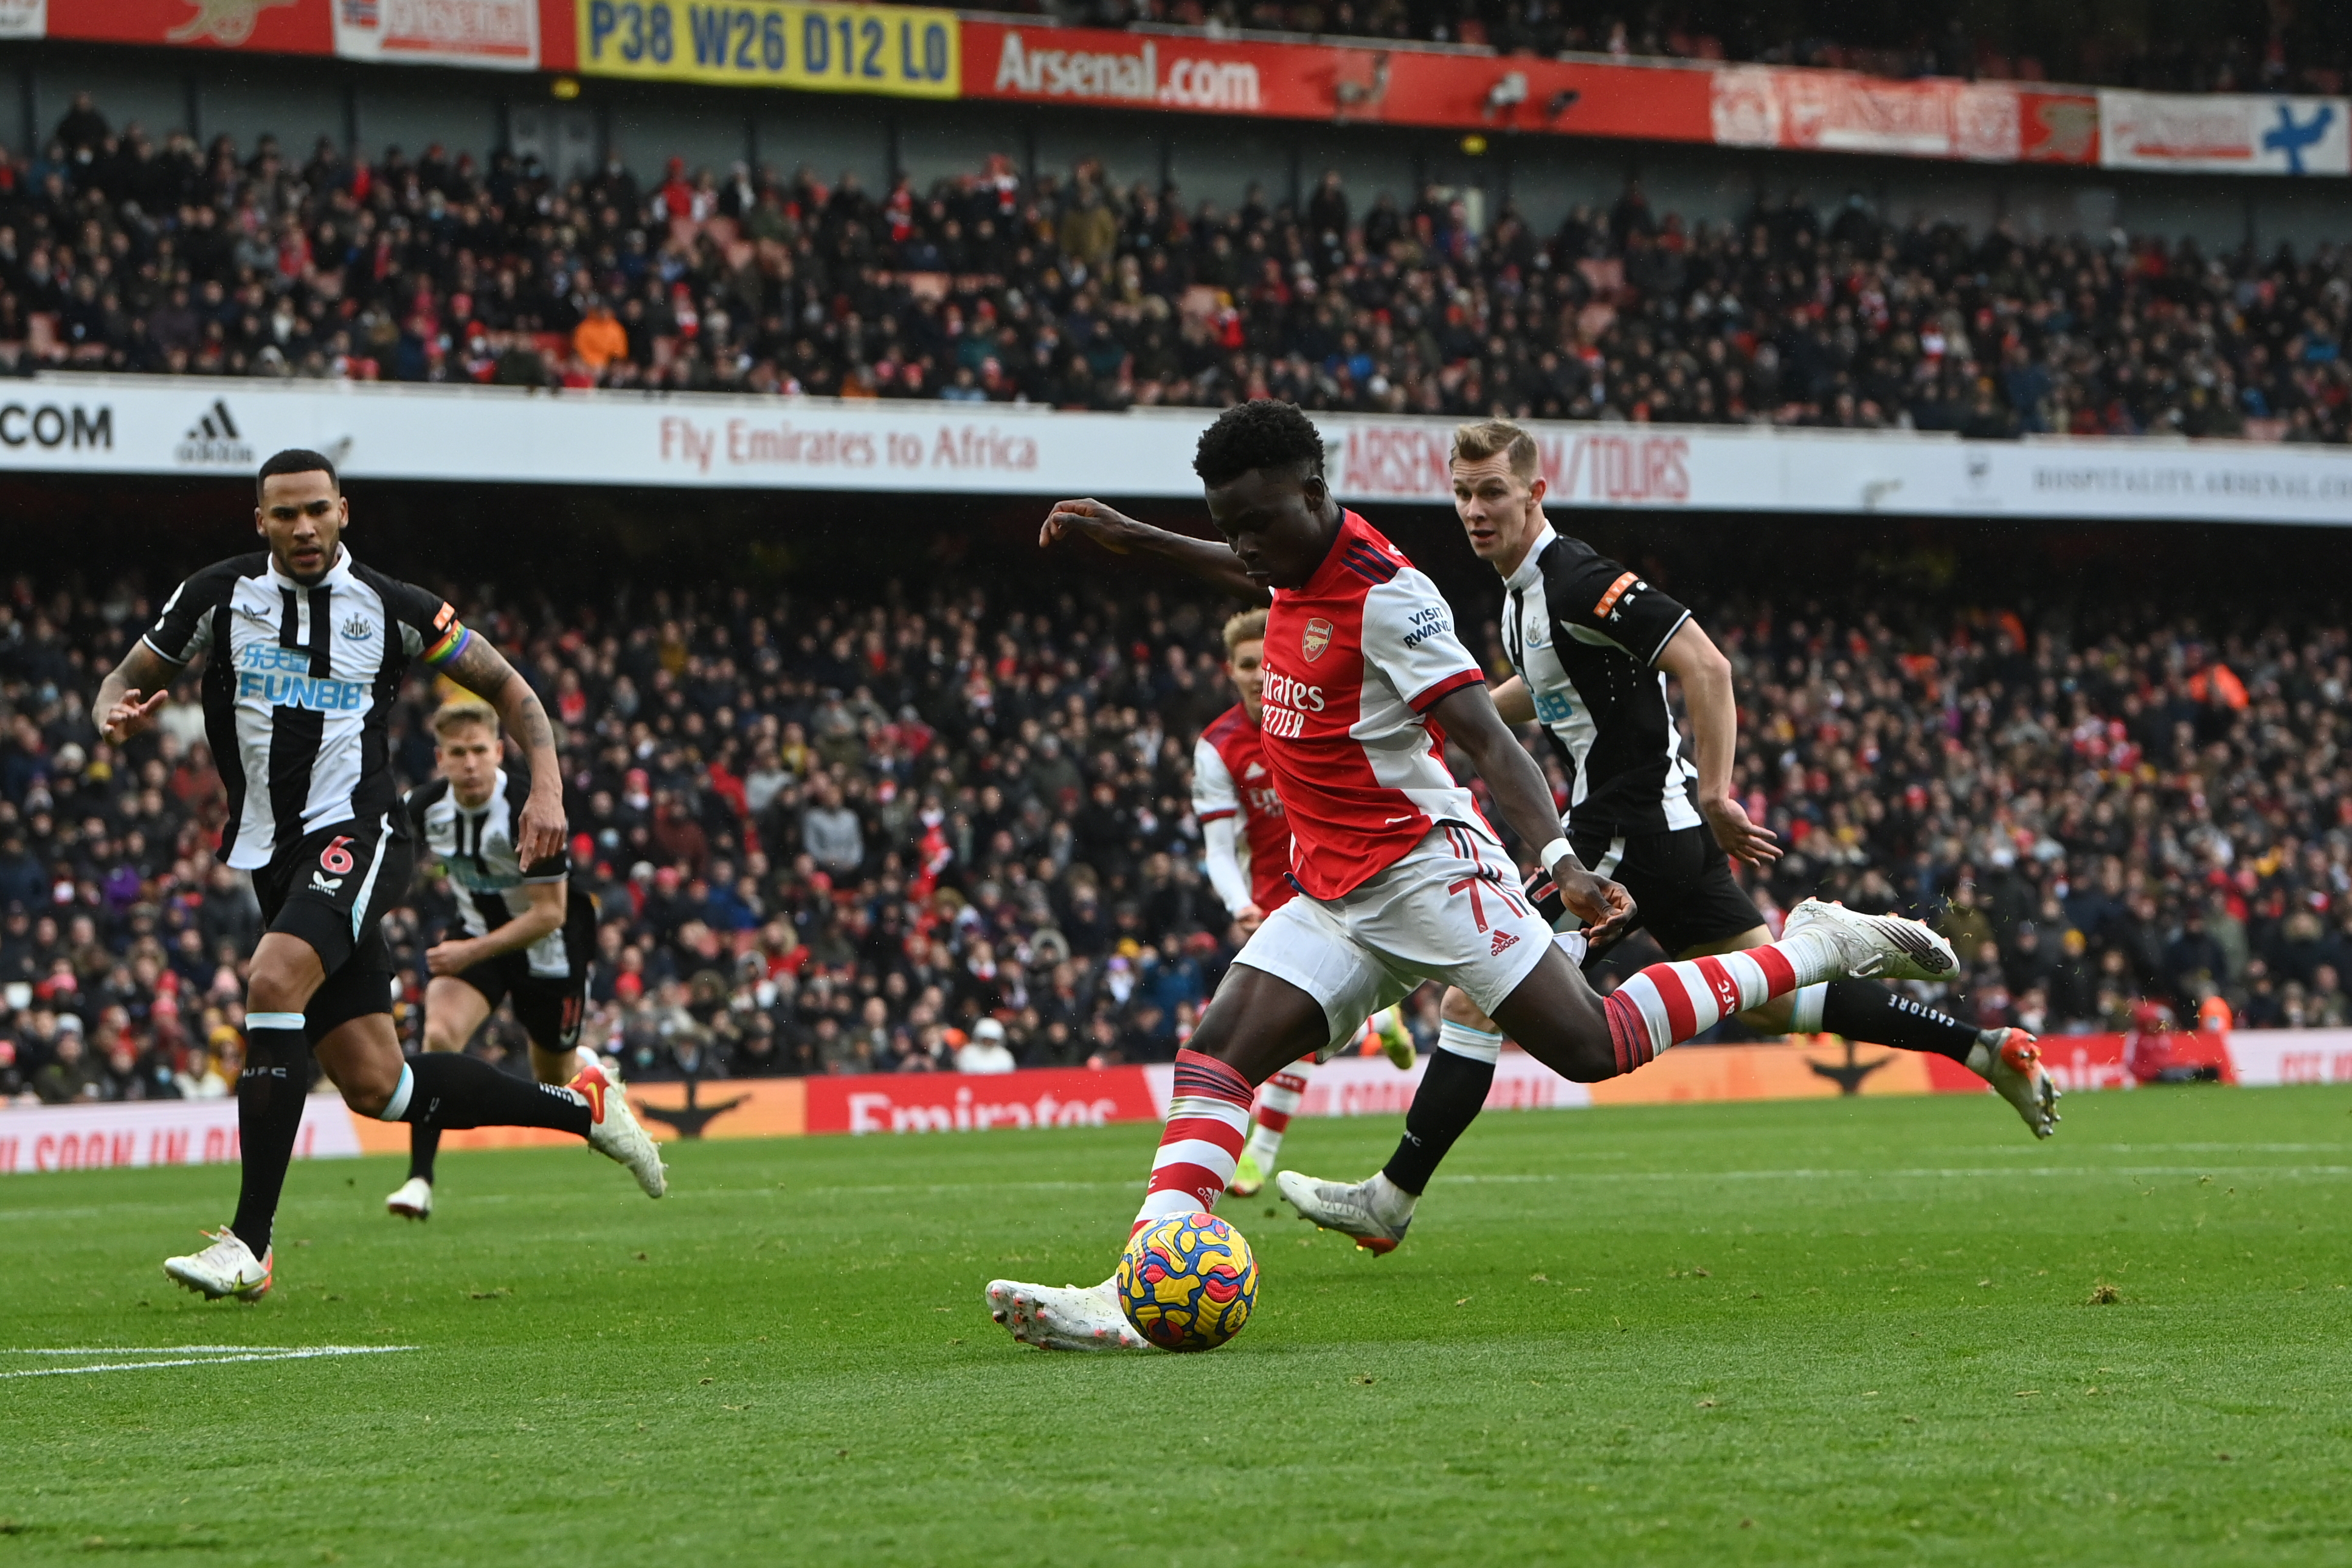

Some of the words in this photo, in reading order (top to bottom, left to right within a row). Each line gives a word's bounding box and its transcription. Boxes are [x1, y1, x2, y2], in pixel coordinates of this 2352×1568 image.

[591, 1, 672, 63] P38
[690, 5, 784, 72] W26
[804, 13, 883, 77] D12
[995, 32, 1260, 109] Arsenal.com
[660, 416, 715, 474] Fly
[728, 418, 876, 468] Emirates
[886, 429, 924, 469] to
[931, 425, 1038, 471] Africa
[1403, 620, 1451, 650] RWAND
[1408, 607, 1444, 626] VISIT
[240, 672, 364, 710] FUN88
[320, 835, 355, 876] 6
[1448, 877, 1489, 934] 7
[1491, 935, 1520, 957] adidas
[1887, 993, 1955, 1027] CASTORE
